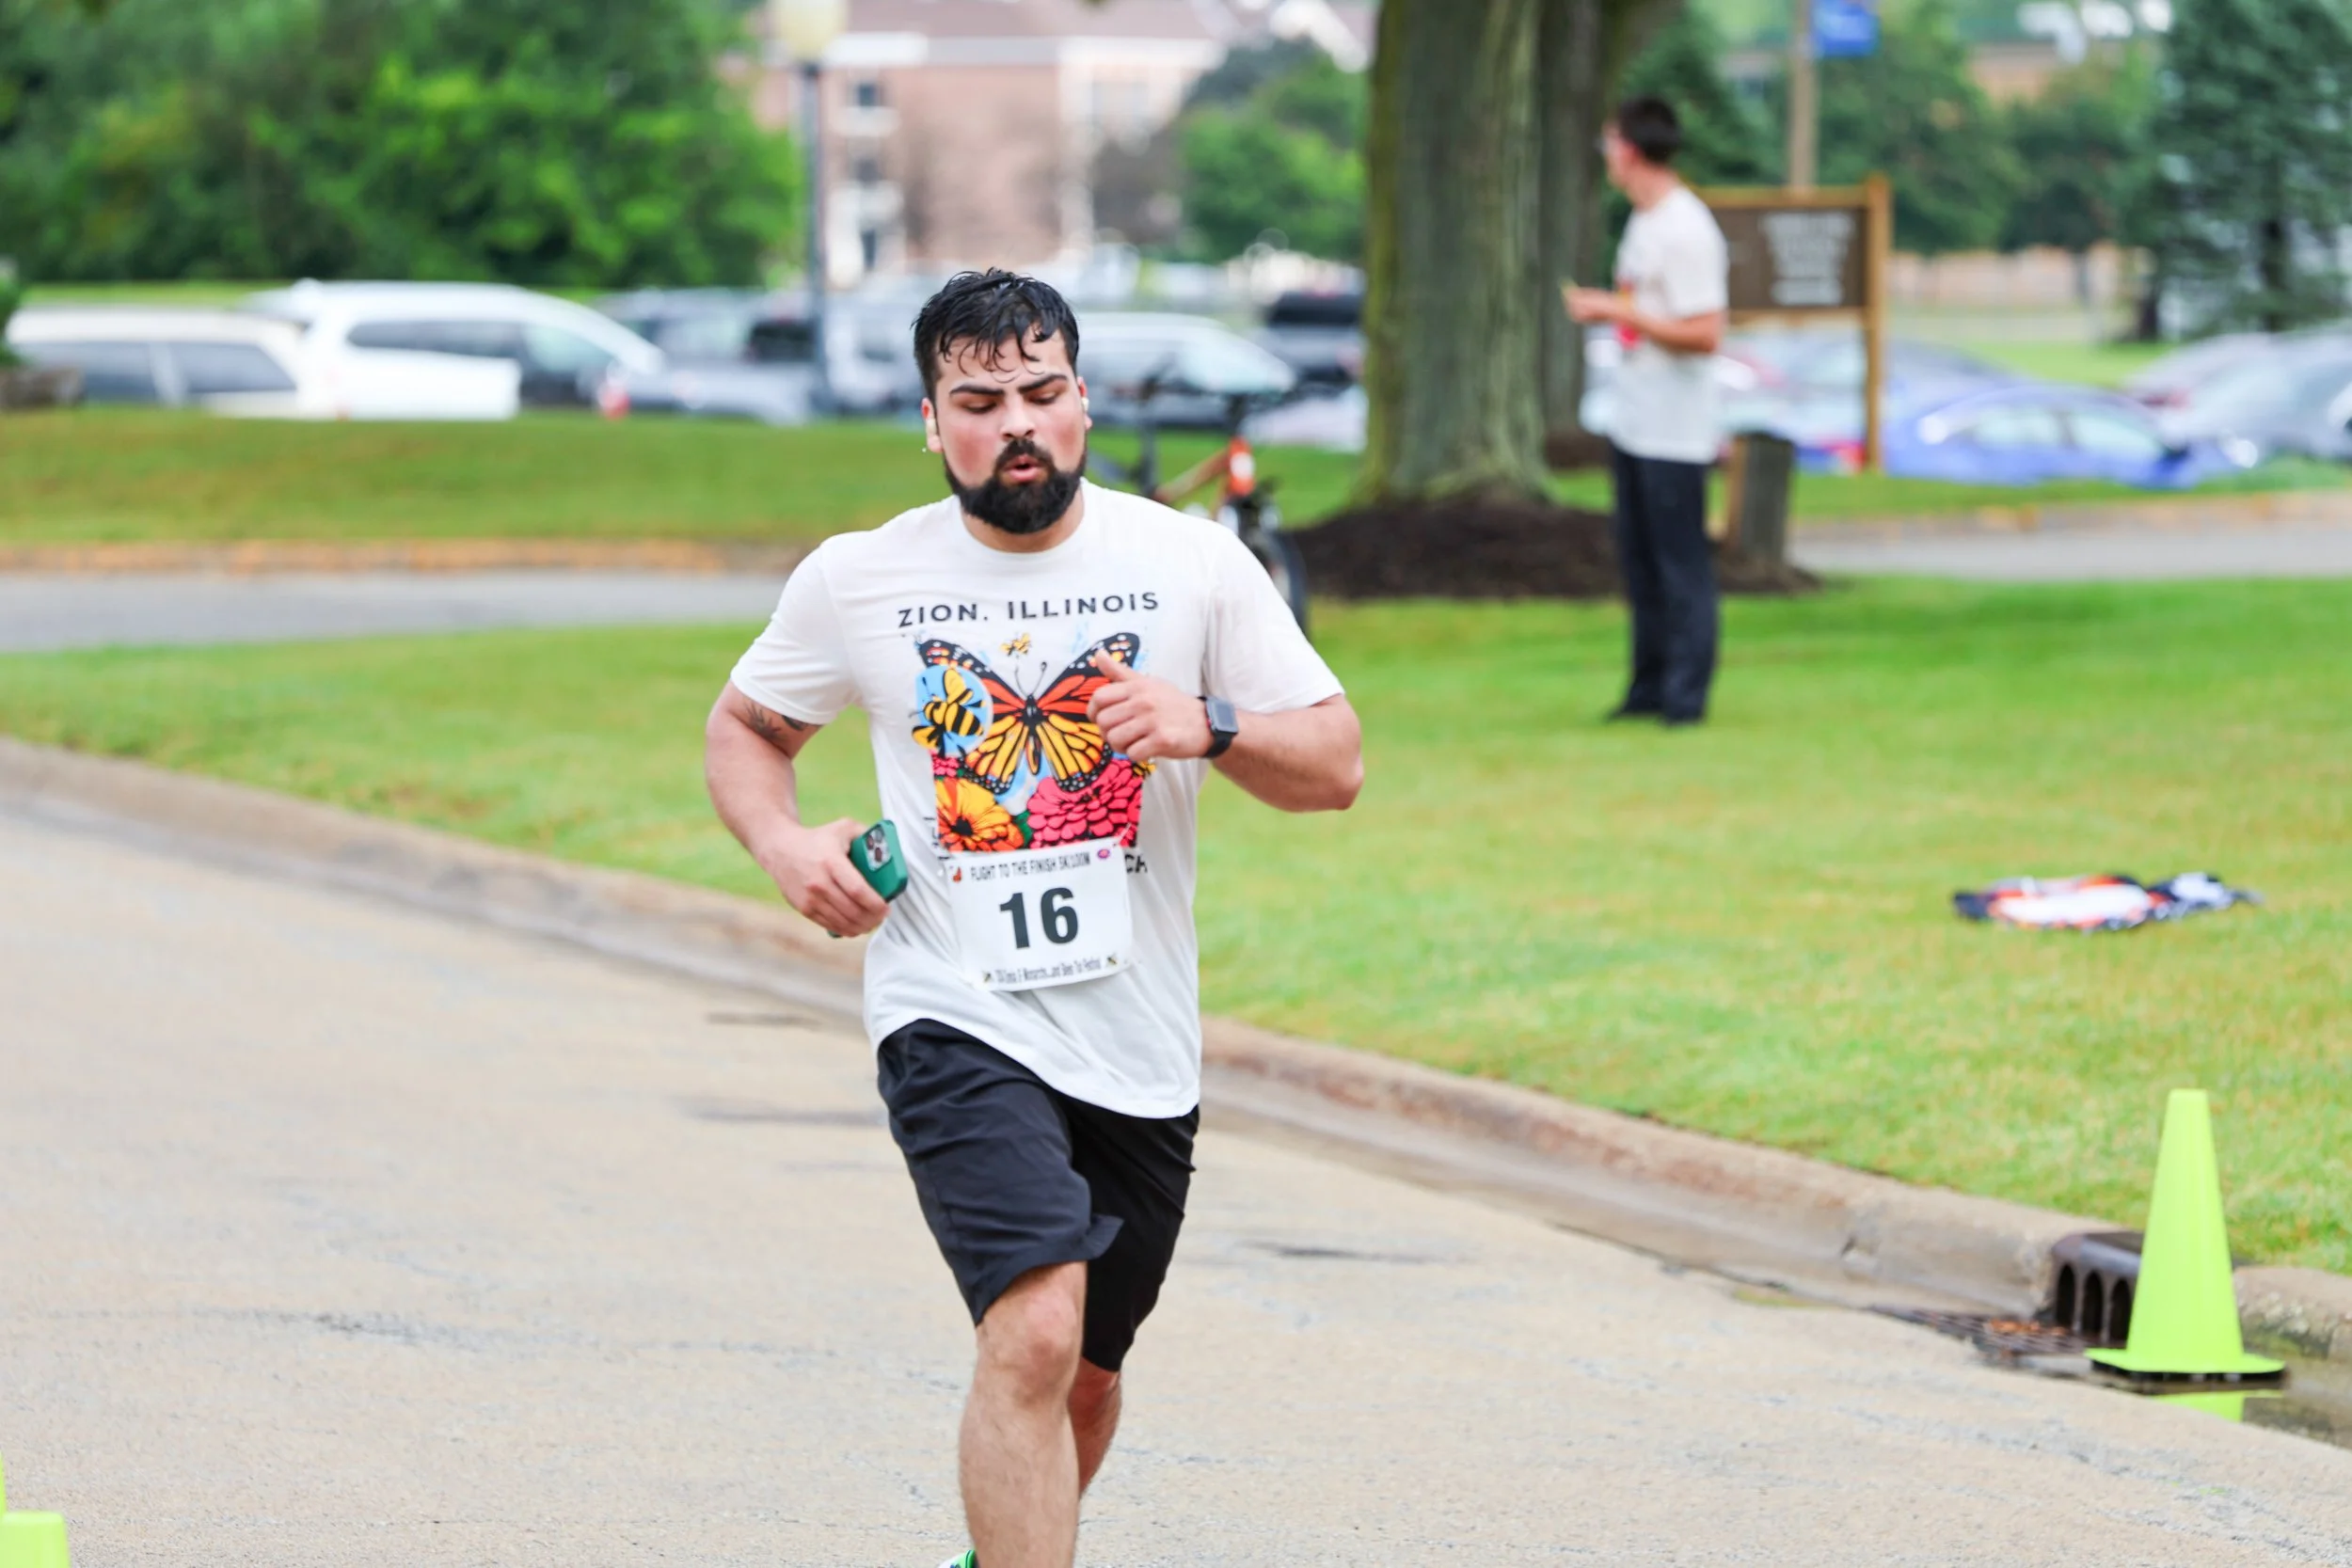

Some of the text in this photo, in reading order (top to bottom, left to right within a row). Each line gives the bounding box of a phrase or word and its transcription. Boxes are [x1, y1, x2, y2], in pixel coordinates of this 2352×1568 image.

[1008, 592, 1159, 620] ILLINOIS
[970, 864, 995, 881] FLIGHT
[998, 863, 1010, 879] TO
[1011, 860, 1028, 877] THE
[1029, 857, 1056, 874] FINISH
[999, 887, 1079, 950] 16
